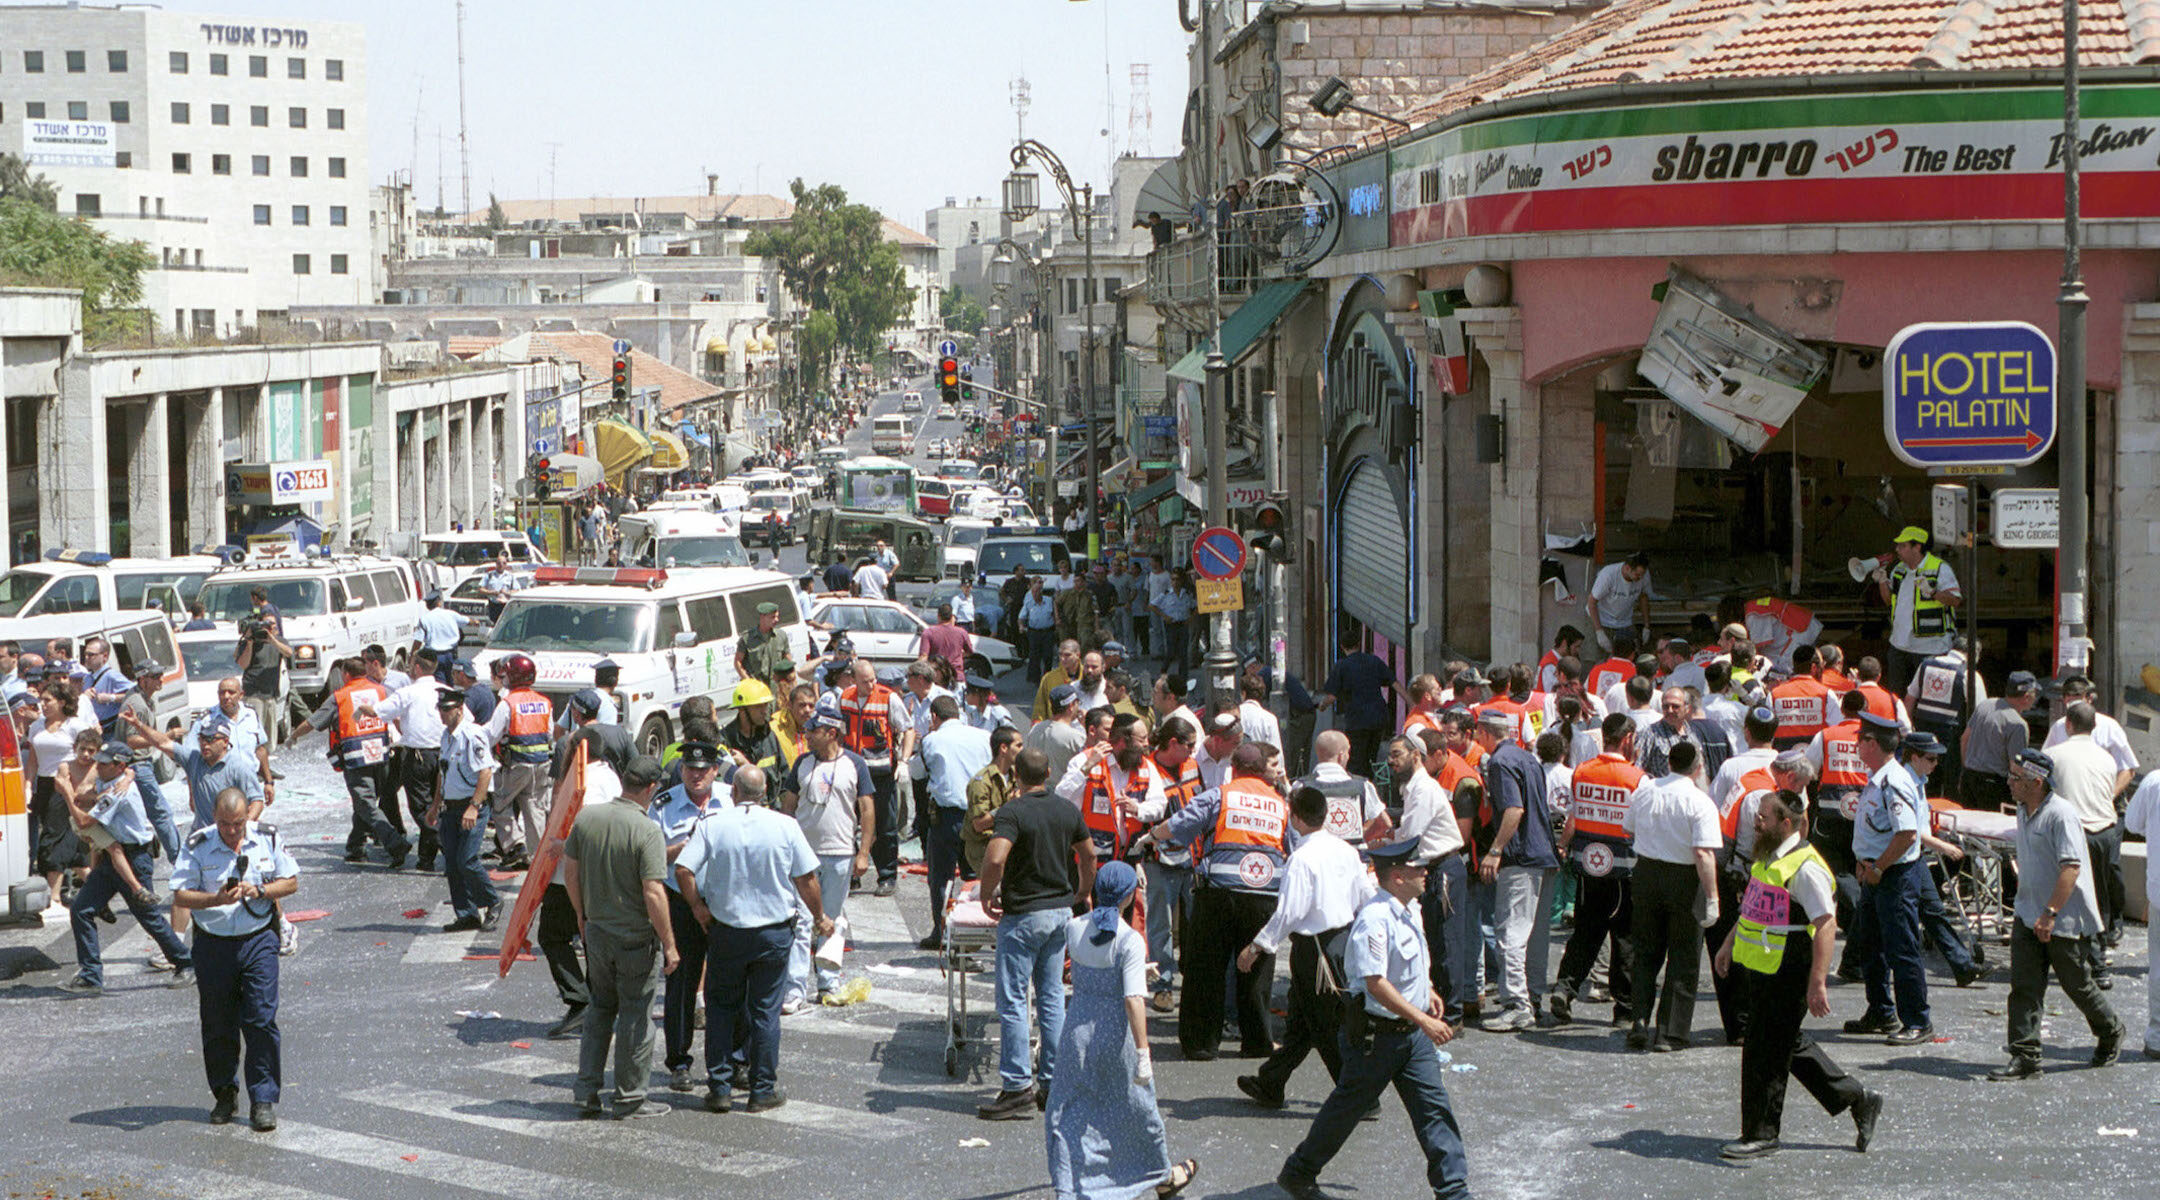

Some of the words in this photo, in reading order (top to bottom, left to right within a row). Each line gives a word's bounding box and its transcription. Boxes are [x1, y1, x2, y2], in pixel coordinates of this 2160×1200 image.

[200, 23, 256, 44] אשדר
[262, 27, 308, 48] מרכז
[33, 123, 69, 135] אשדר
[76, 125, 107, 137] מרכז
[1651, 135, 1818, 181] sbarro
[1824, 128, 1898, 173] כשר
[1903, 145, 1948, 173] The
[1953, 144, 2016, 172] Best
[1561, 144, 1612, 181] כשר
[1507, 163, 1543, 190] Choice
[1901, 351, 2049, 395] HOTEL
[1918, 399, 2030, 427] PALATIN
[2003, 530, 2024, 540] KING
[460, 605, 483, 613] POLICE
[360, 631, 378, 643] POLICE
[520, 702, 546, 714] חובש
[1782, 699, 1813, 709] חובש
[1579, 784, 1625, 803] חובש
